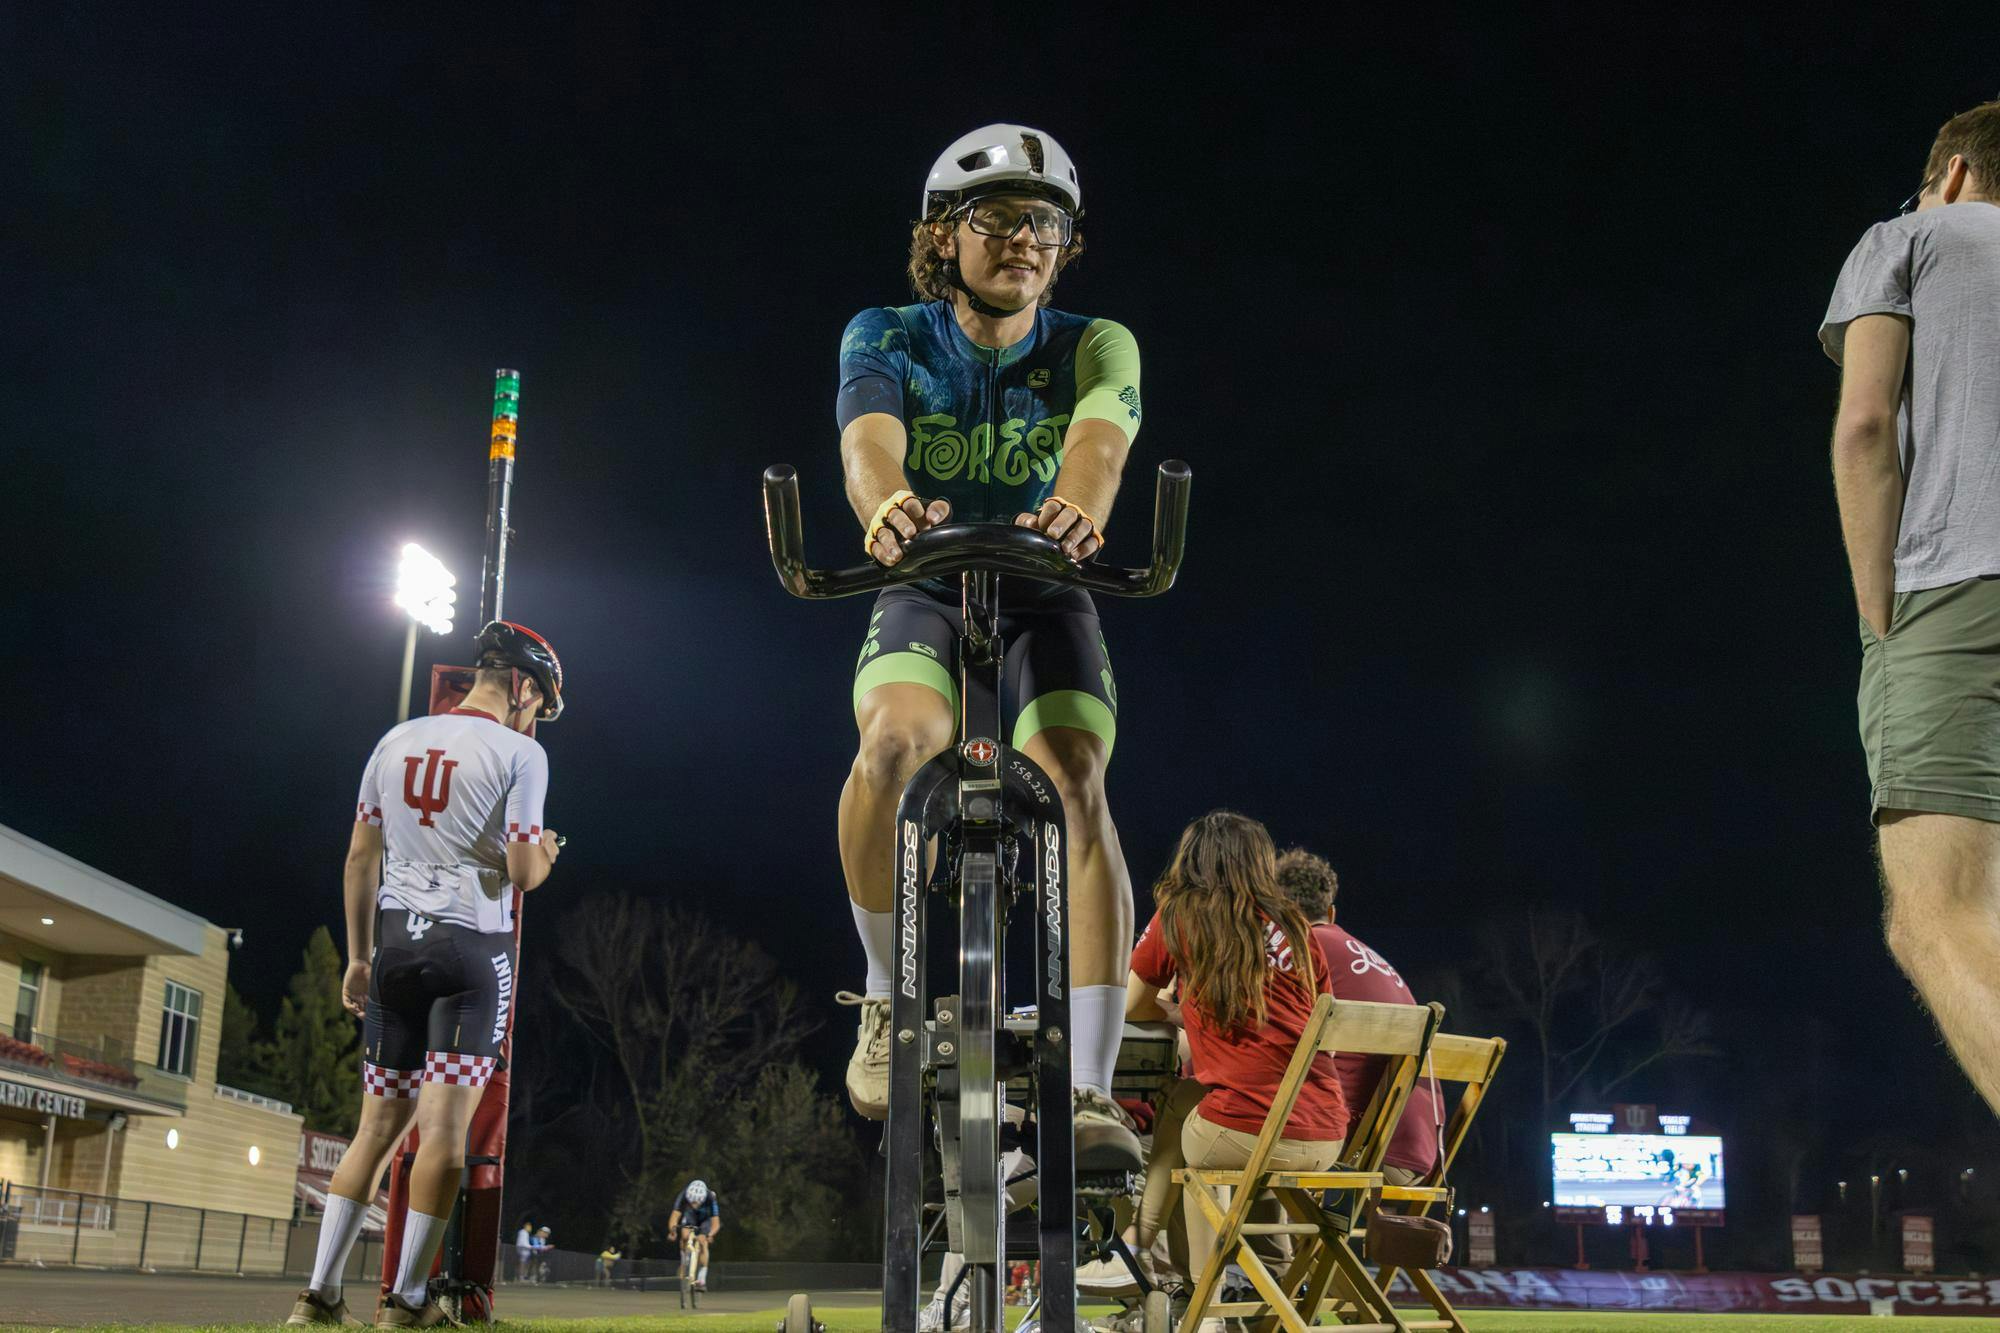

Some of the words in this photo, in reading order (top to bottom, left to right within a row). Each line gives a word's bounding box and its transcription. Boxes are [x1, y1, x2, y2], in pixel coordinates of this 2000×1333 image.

[908, 413, 1070, 486] FOREST
[902, 820, 918, 999] SCHWINN
[1045, 821, 1062, 1000] SCHWINN
[491, 952, 512, 1044] INDIANA
[36, 1090, 86, 1119] CENTER
